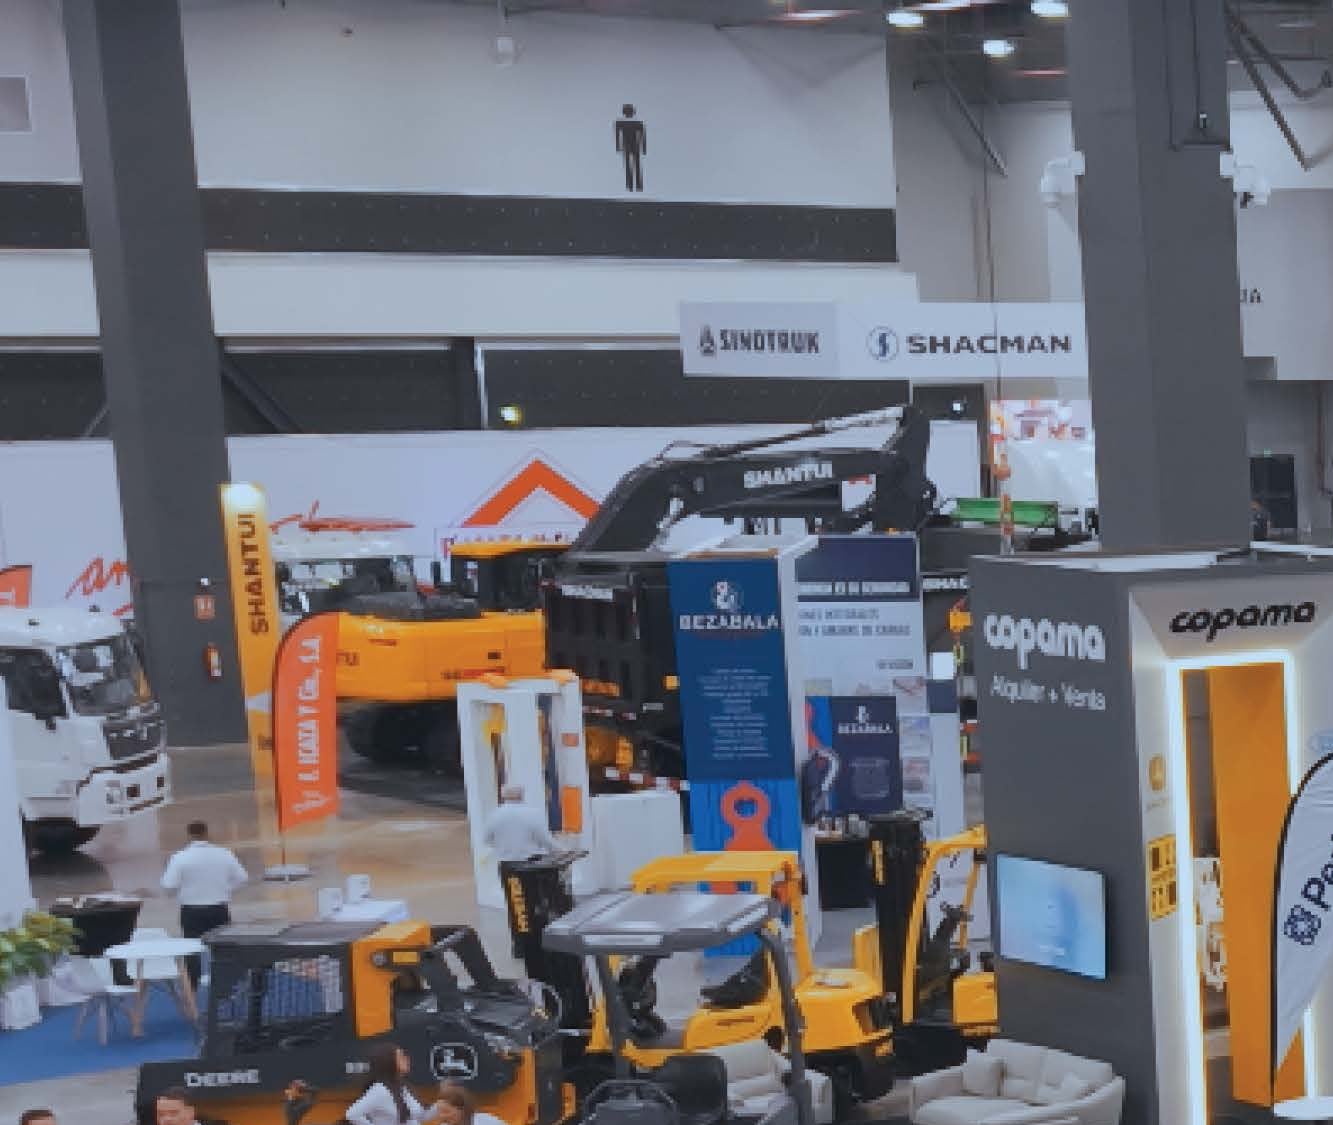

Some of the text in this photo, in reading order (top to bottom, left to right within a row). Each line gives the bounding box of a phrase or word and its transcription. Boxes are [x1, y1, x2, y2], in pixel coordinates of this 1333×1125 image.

[719, 328, 820, 353] SINOTRUK
[906, 334, 1072, 354] SHACMAN
[237, 513, 269, 635] SHANTUI
[1169, 601, 1315, 642] copama
[983, 614, 1106, 671] copama
[991, 673, 1045, 703] Alquiler
[1061, 682, 1106, 711] Venta
